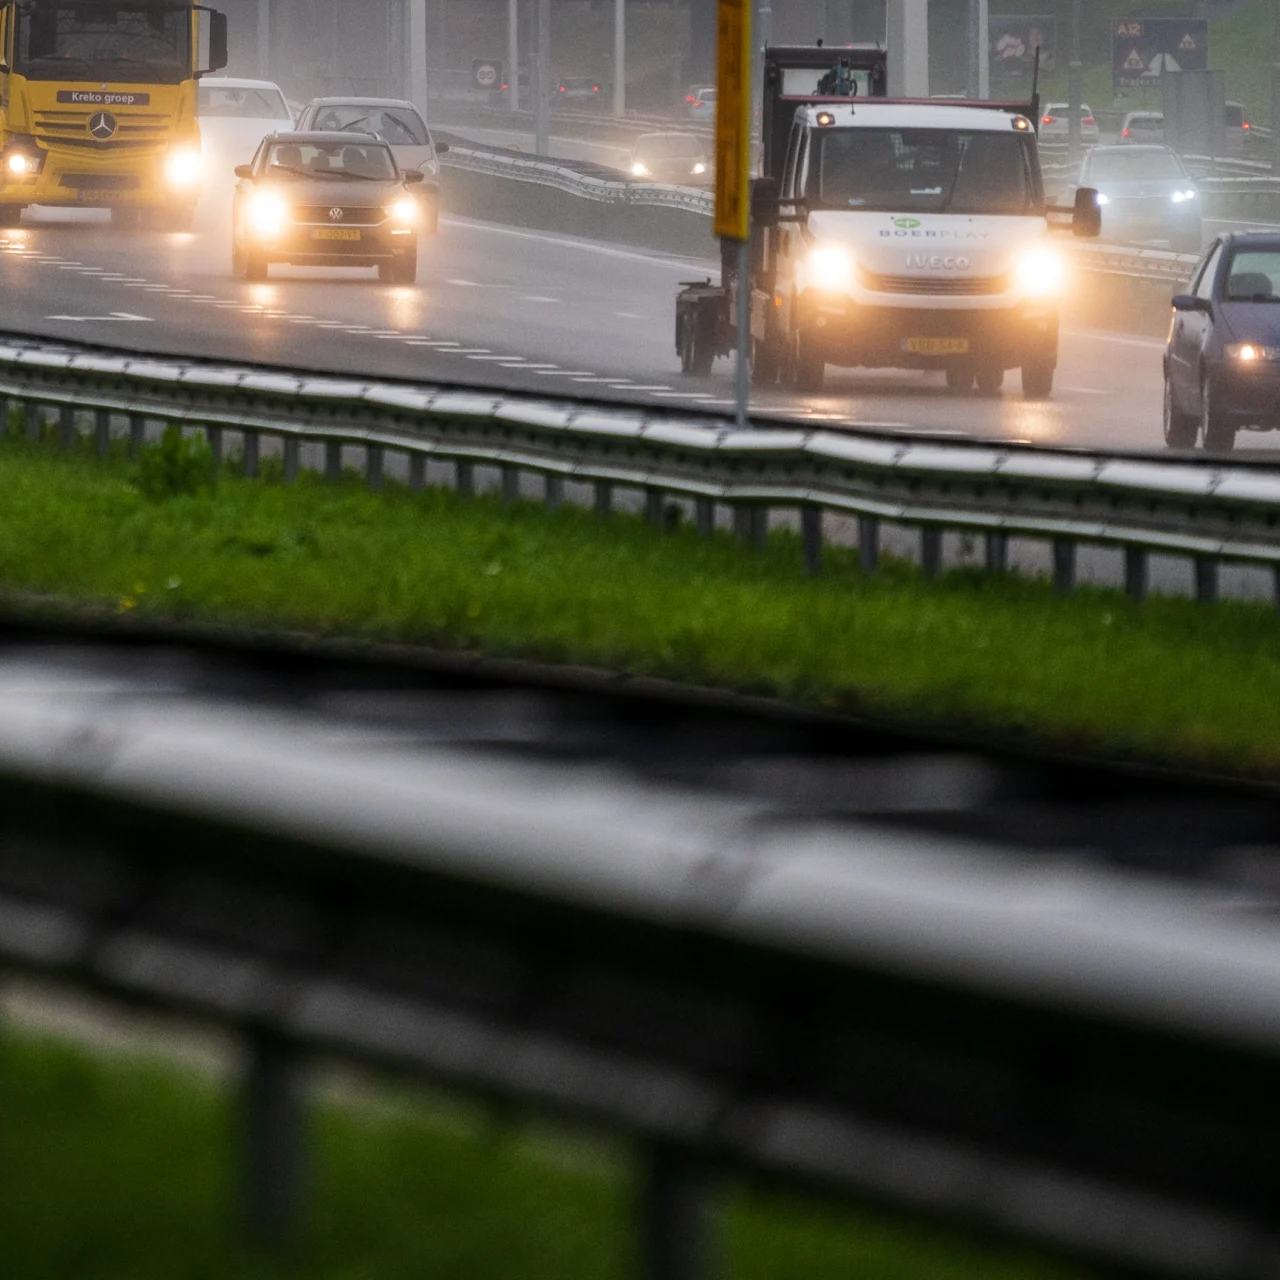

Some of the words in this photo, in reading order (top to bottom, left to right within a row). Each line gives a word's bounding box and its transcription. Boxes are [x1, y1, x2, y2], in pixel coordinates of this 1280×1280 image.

[1117, 23, 1141, 36] A12
[71, 91, 102, 102] Kreko
[104, 94, 135, 105] groep
[905, 254, 970, 271] IVECO
